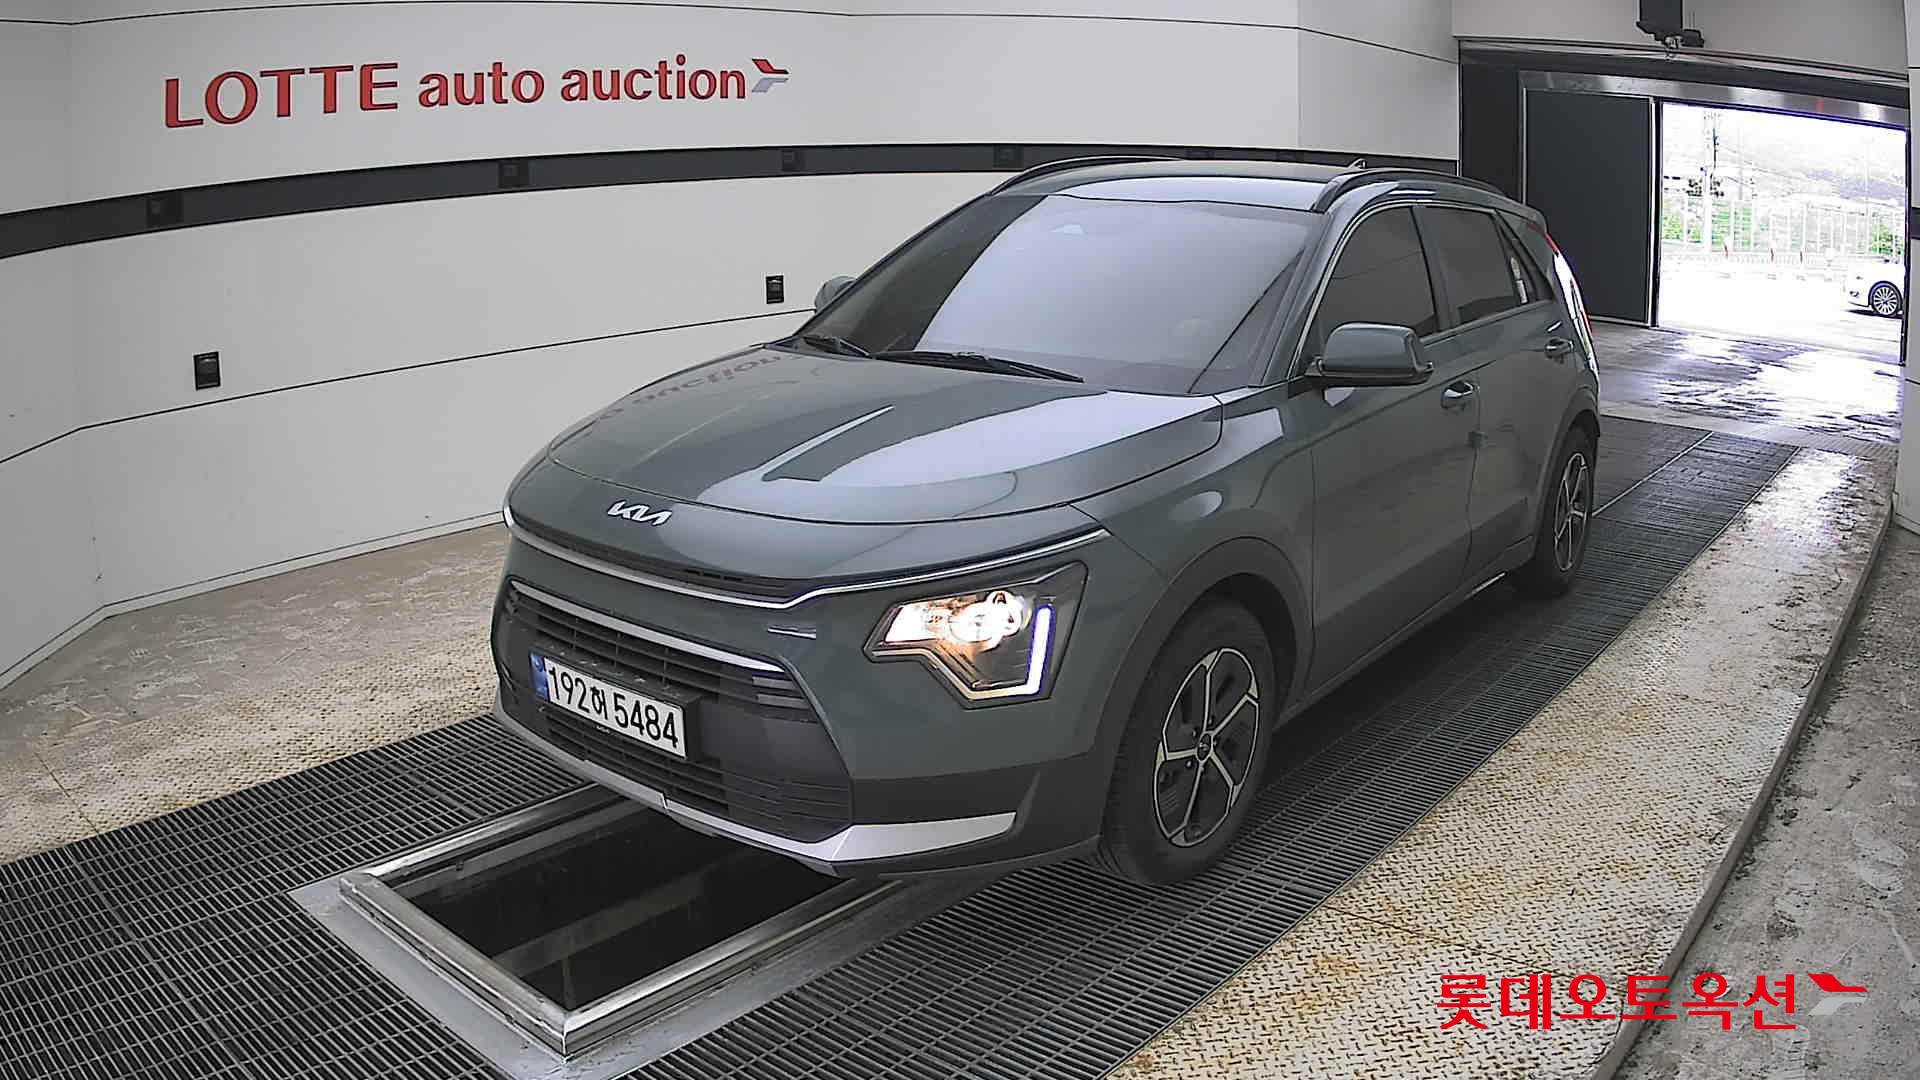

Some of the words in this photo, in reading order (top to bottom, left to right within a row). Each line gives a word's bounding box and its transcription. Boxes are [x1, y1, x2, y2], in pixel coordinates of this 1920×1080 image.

[164, 62, 399, 128] LOTTE
[418, 62, 546, 108] auto
[560, 54, 748, 101] auction
[607, 500, 673, 525] KIA
[613, 692, 679, 748] 5484
